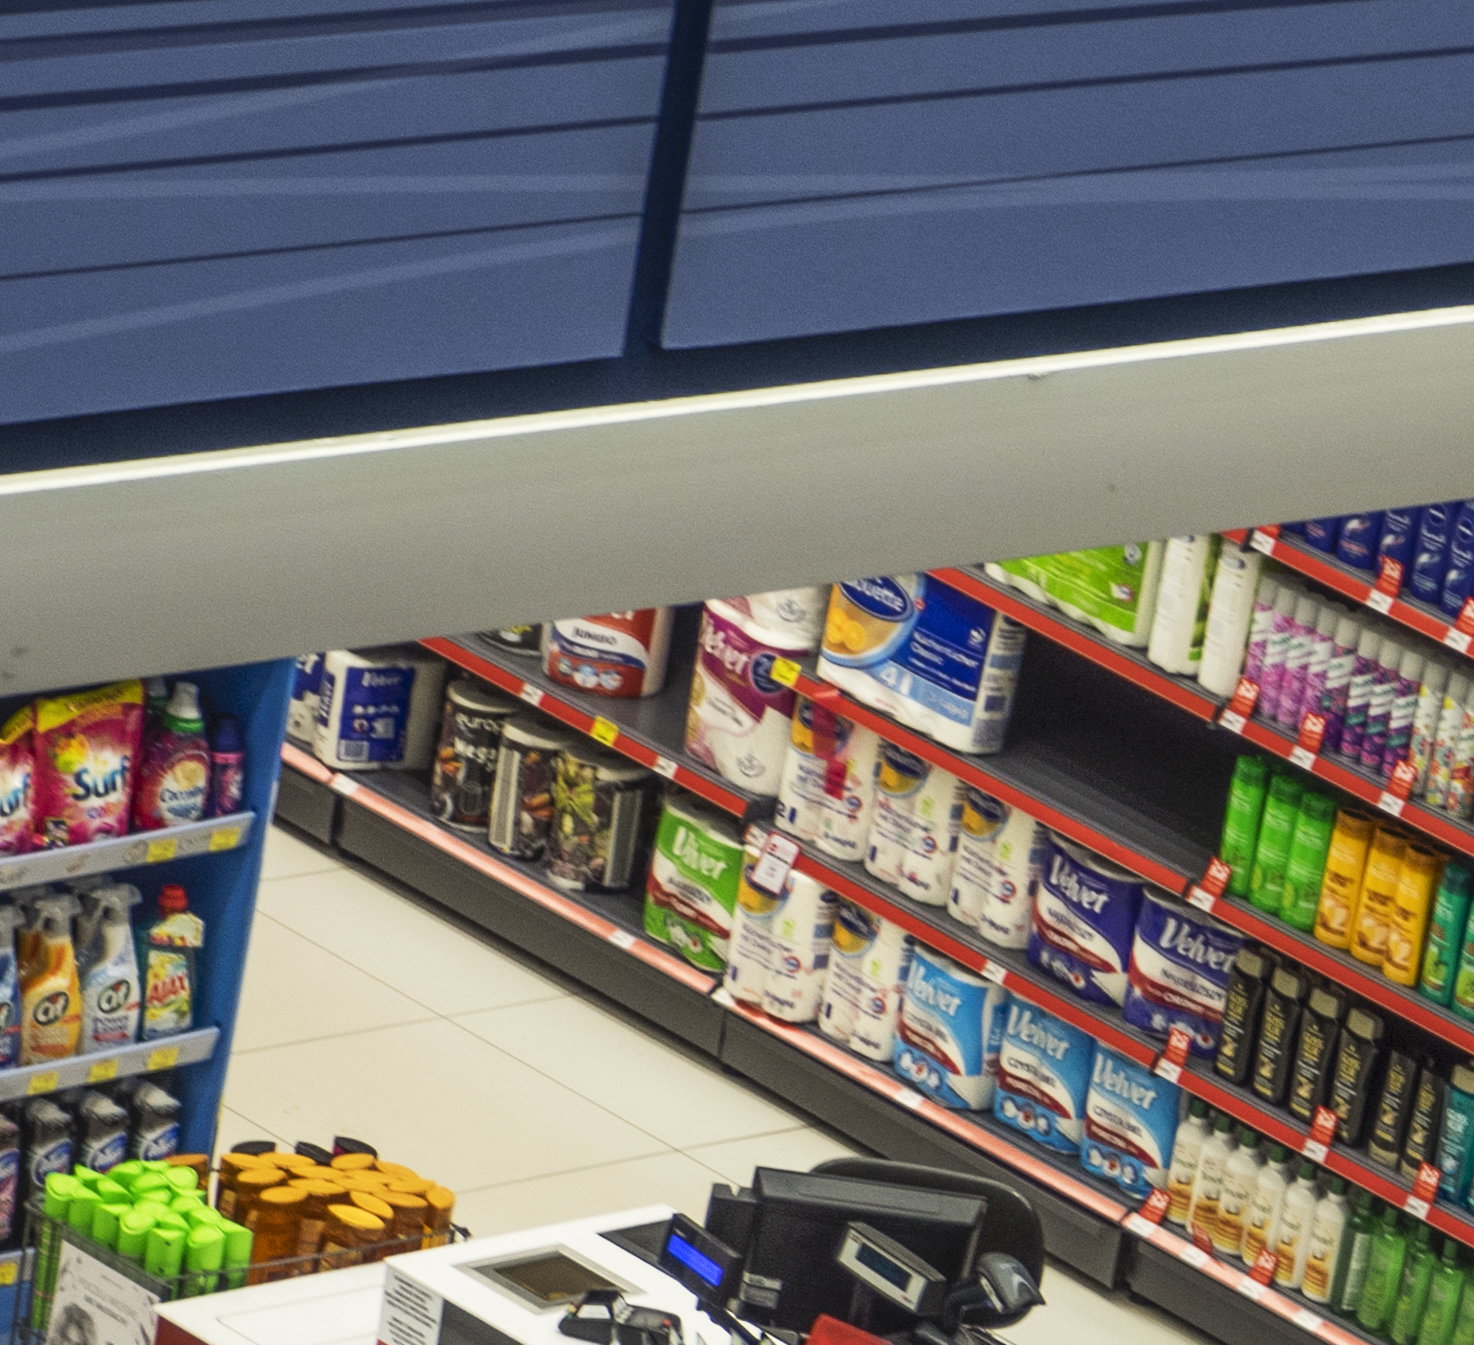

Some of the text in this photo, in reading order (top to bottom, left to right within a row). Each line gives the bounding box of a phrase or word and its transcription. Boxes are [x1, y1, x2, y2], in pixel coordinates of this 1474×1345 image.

[71, 754, 131, 801] Surf
[1050, 855, 1108, 915] Velvet
[1162, 917, 1236, 974] Velvet
[907, 959, 960, 1016] Velvet
[1007, 1004, 1068, 1061] Velvet
[1095, 1055, 1155, 1110] Velvet
